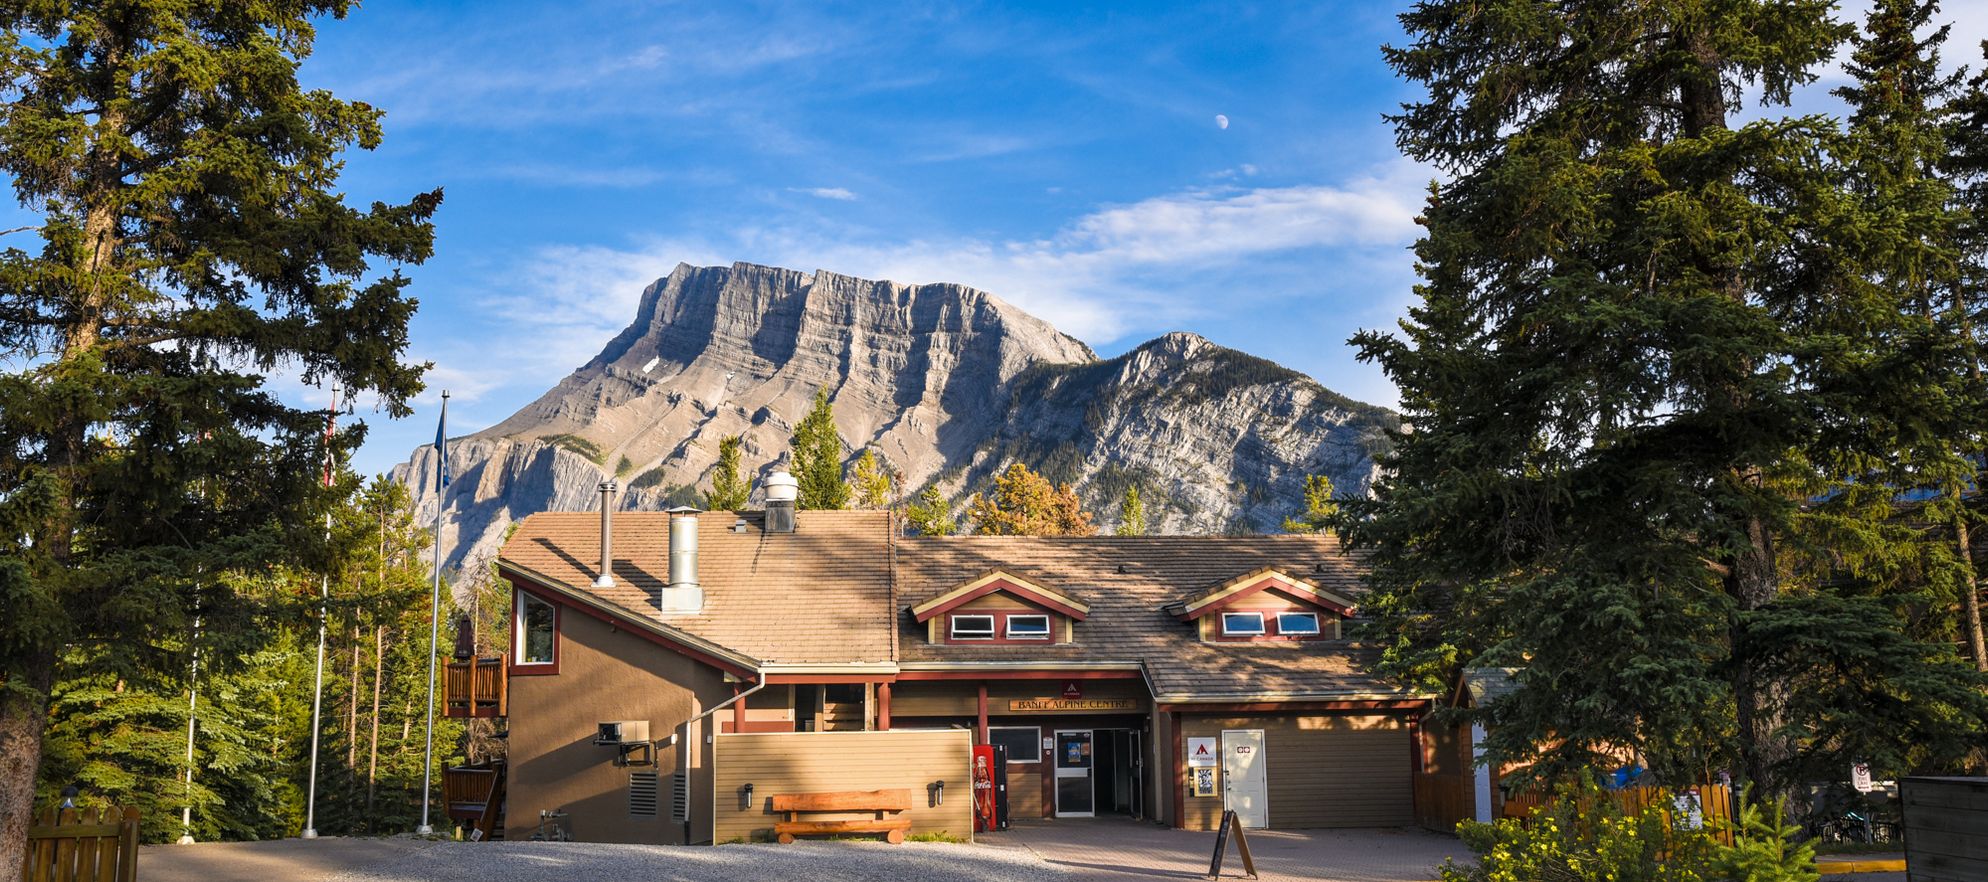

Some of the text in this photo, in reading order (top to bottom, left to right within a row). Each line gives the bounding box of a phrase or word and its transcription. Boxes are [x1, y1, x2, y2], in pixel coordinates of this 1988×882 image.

[1018, 700, 1128, 709] BANFF ALPINE CENTRE
